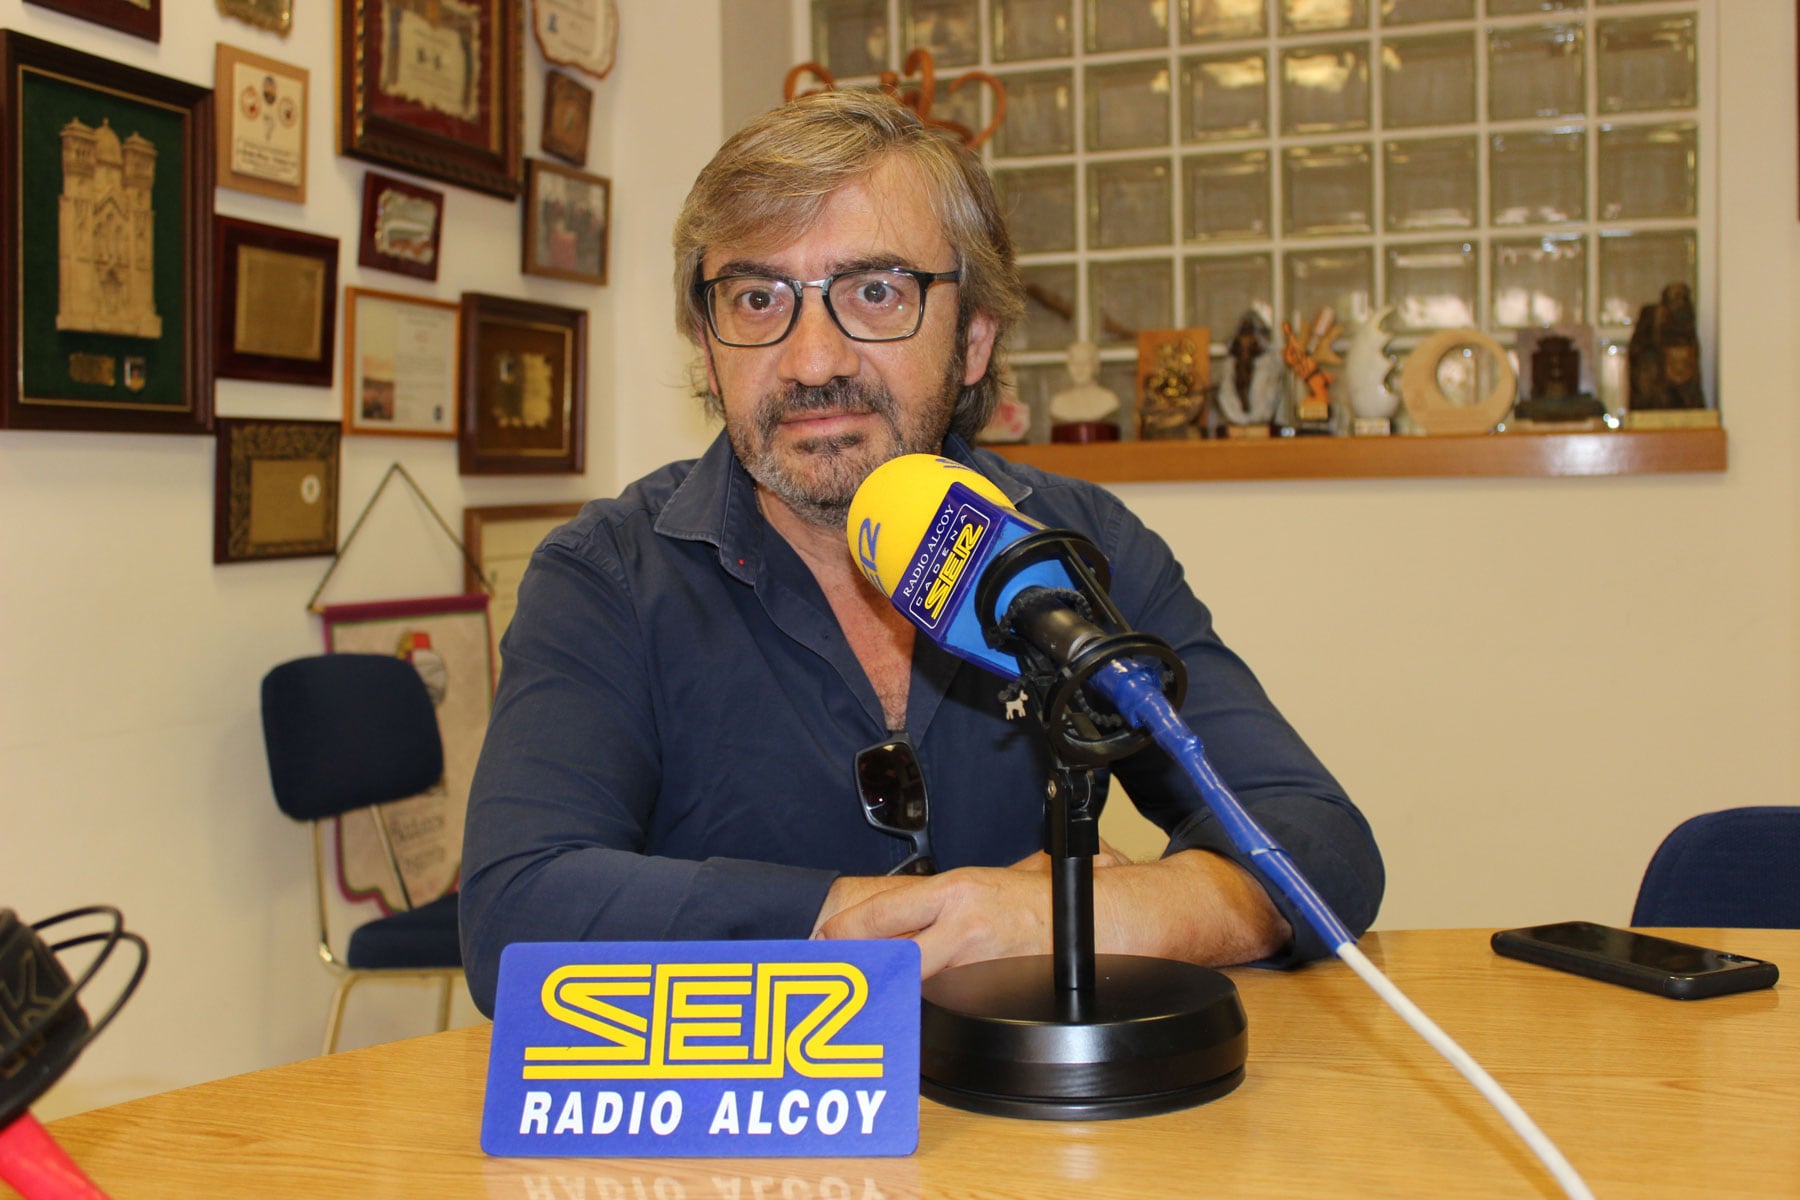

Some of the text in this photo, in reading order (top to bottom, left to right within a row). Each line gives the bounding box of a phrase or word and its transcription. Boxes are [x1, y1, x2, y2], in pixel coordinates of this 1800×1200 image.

[903, 504, 954, 597] RADIO ALCOY
[915, 514, 967, 606] CADENA
[924, 523, 984, 620] SER
[522, 962, 884, 1080] SER
[519, 1089, 887, 1136] RADIO ALCOY
